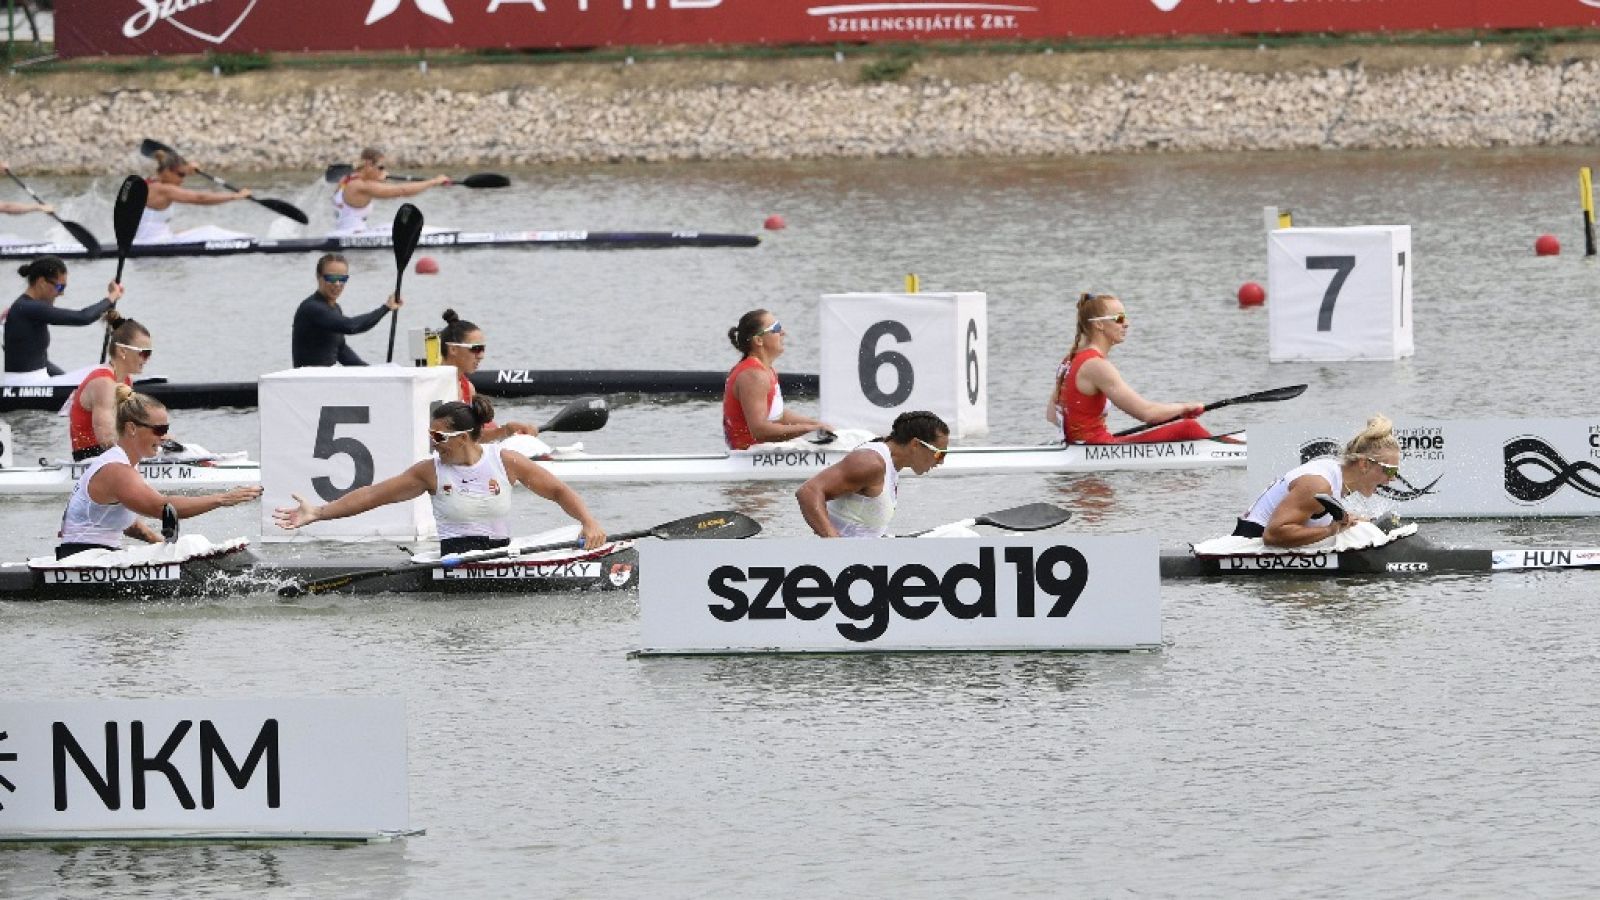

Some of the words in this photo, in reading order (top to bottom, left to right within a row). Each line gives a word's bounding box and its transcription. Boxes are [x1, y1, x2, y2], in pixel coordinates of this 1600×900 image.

[1306, 255, 1356, 331] 7
[858, 319, 914, 408] 6
[965, 317, 979, 406] 6
[496, 368, 534, 384] NZL
[2, 386, 16, 398] K.
[18, 386, 54, 398] IMRIE
[1398, 435, 1445, 450] anoe
[311, 405, 375, 503] 5
[752, 452, 809, 467] PAPOK
[815, 452, 831, 466] N.
[1085, 444, 1177, 461] MAKHNEVA
[1181, 442, 1199, 456] M.
[178, 466, 197, 479] M.
[1523, 550, 1571, 566] HUN
[54, 569, 73, 583] D.
[466, 562, 591, 578] MEDVECZKY
[52, 718, 281, 812] NKM
